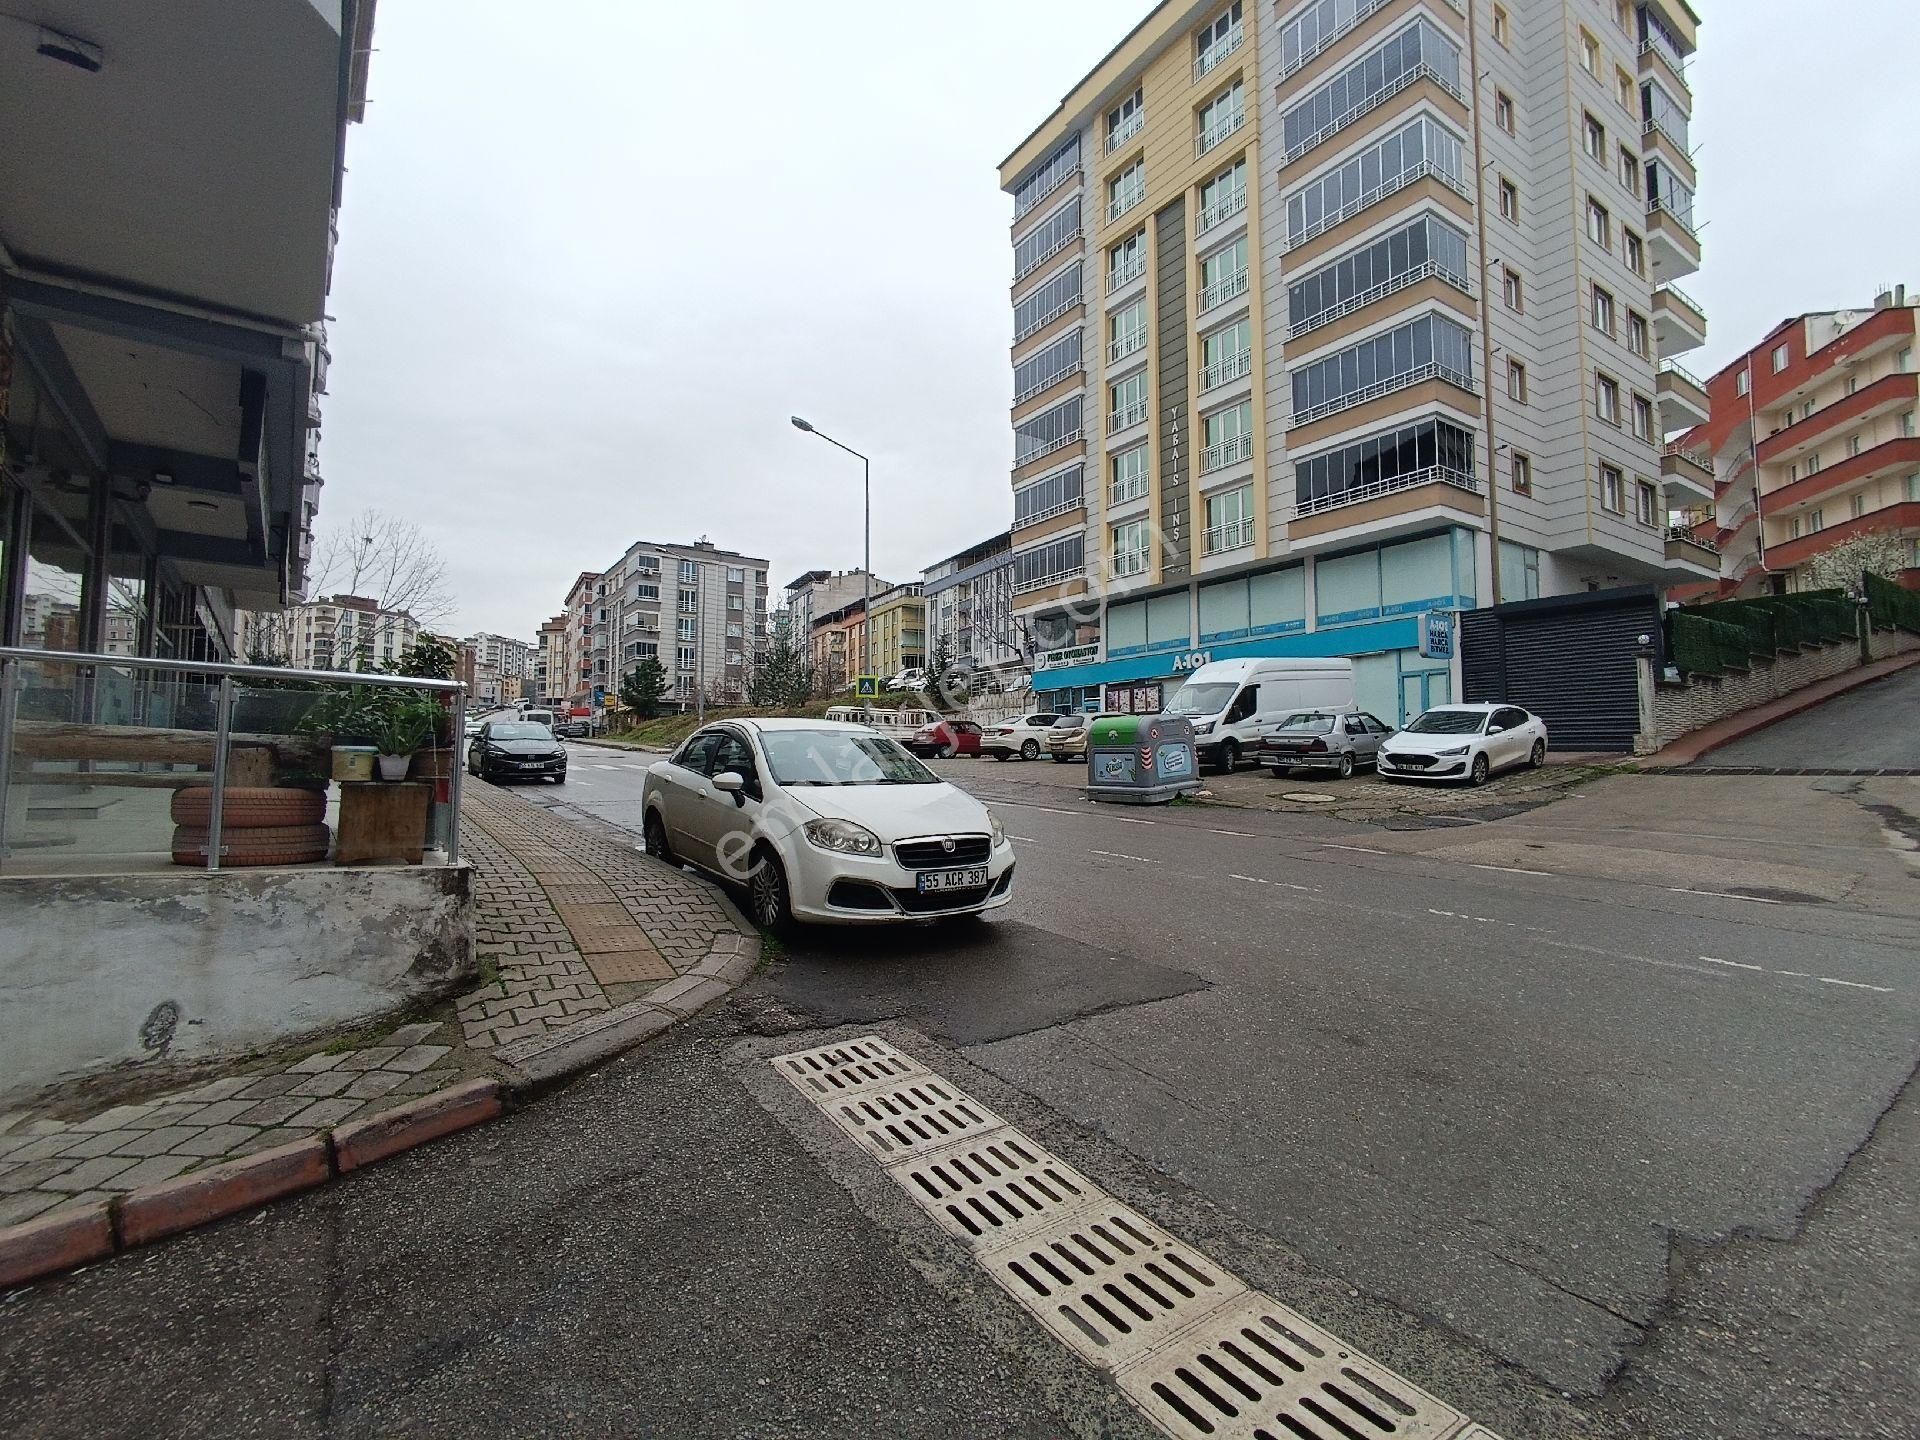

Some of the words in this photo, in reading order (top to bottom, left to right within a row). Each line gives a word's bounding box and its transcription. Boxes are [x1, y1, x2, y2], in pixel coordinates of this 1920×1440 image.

[925, 874, 939, 888] 55
[944, 872, 964, 887] ACR
[967, 870, 986, 885] 387
